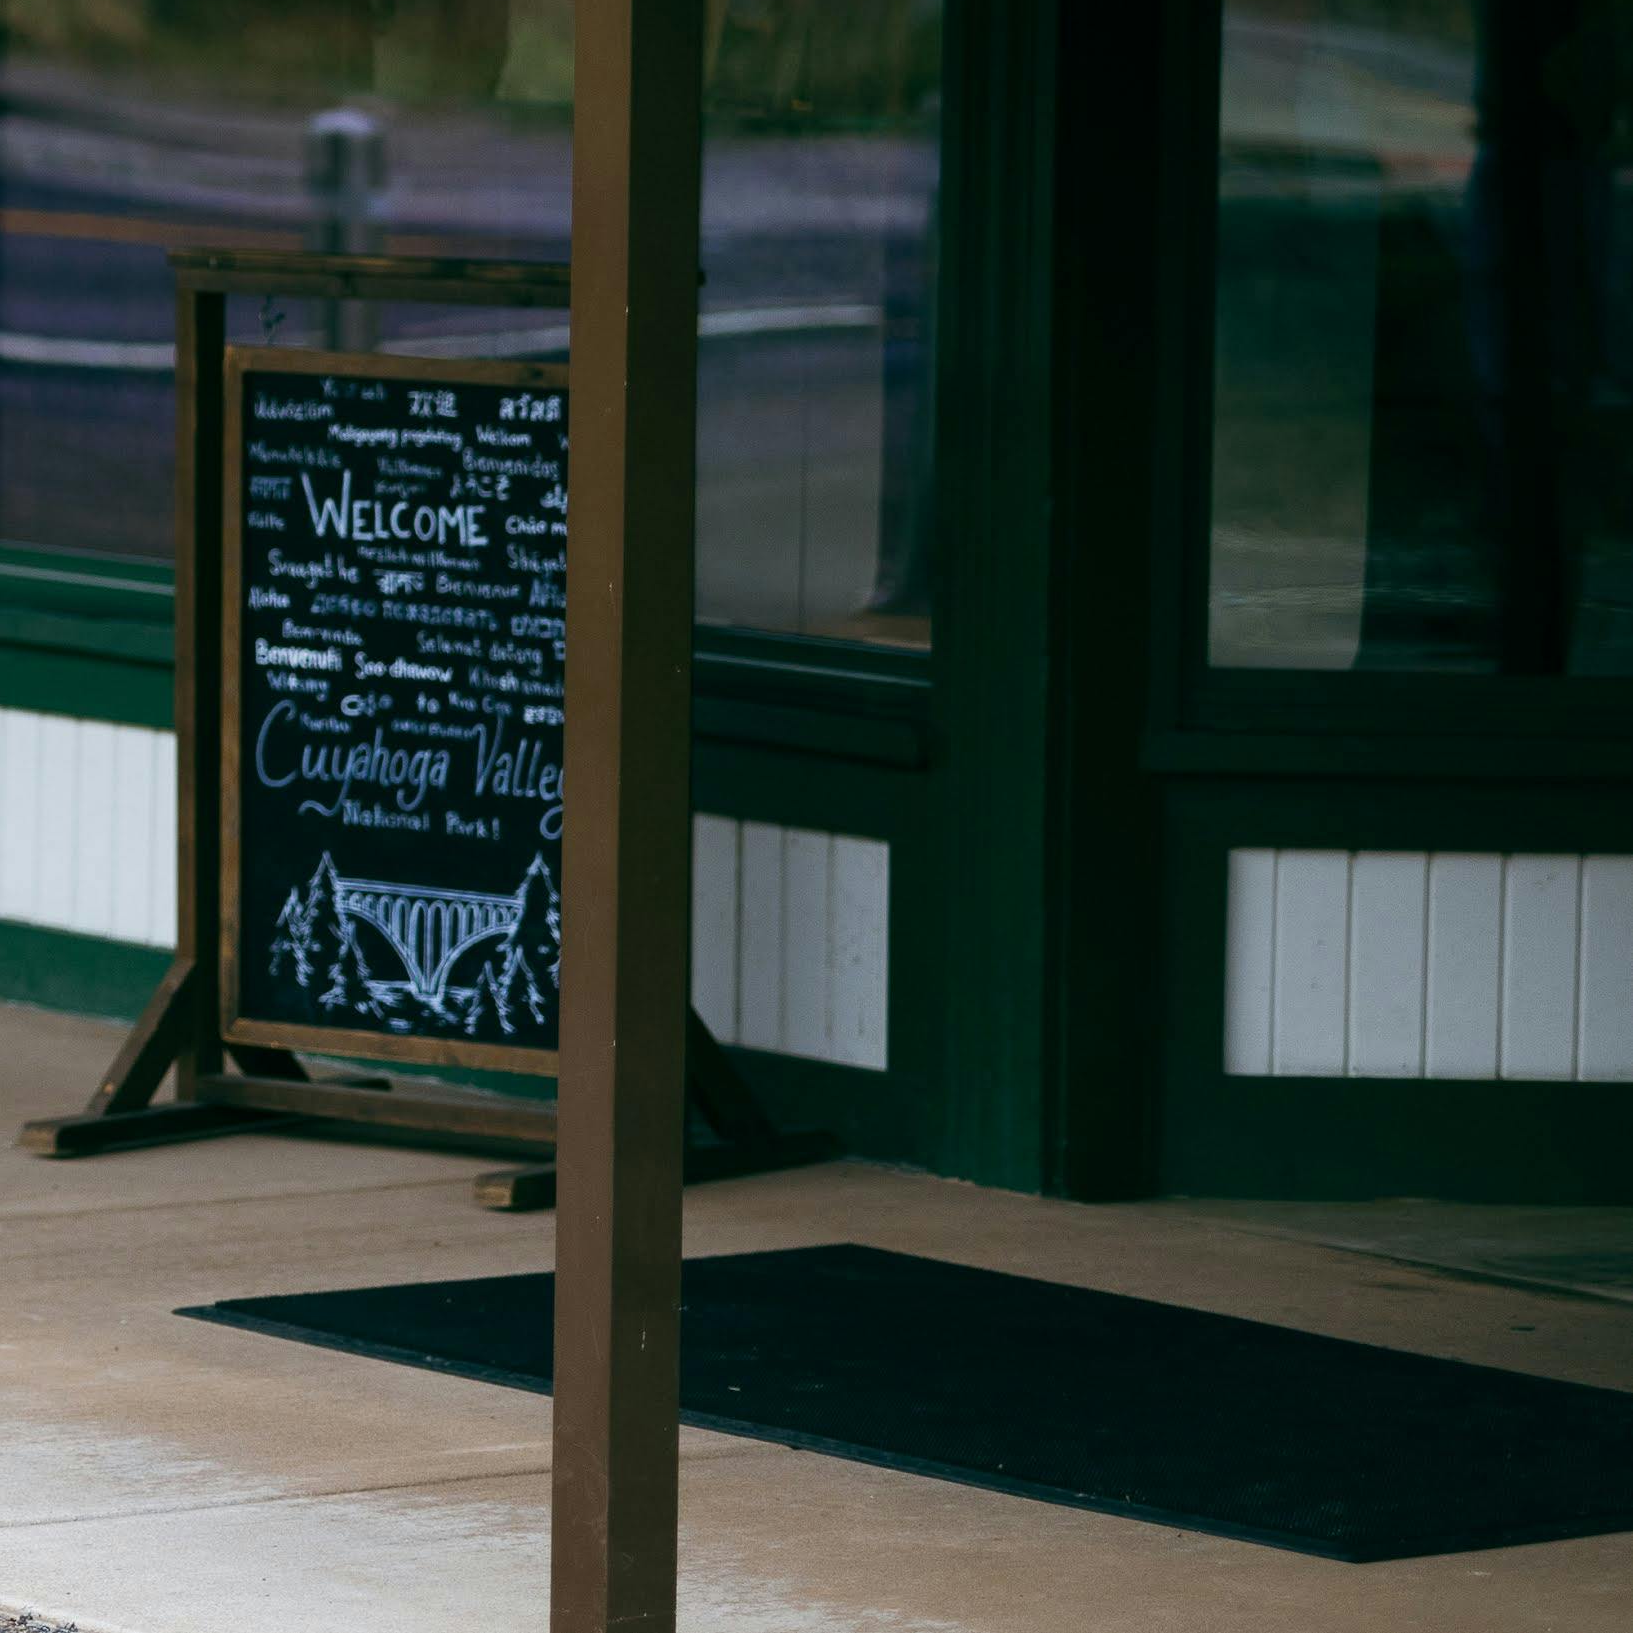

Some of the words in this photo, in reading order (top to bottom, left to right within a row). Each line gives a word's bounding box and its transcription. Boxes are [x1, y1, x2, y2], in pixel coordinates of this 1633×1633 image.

[300, 469, 489, 547] WELCOME
[255, 698, 451, 816] Cuyahoga
[342, 799, 430, 833] National
